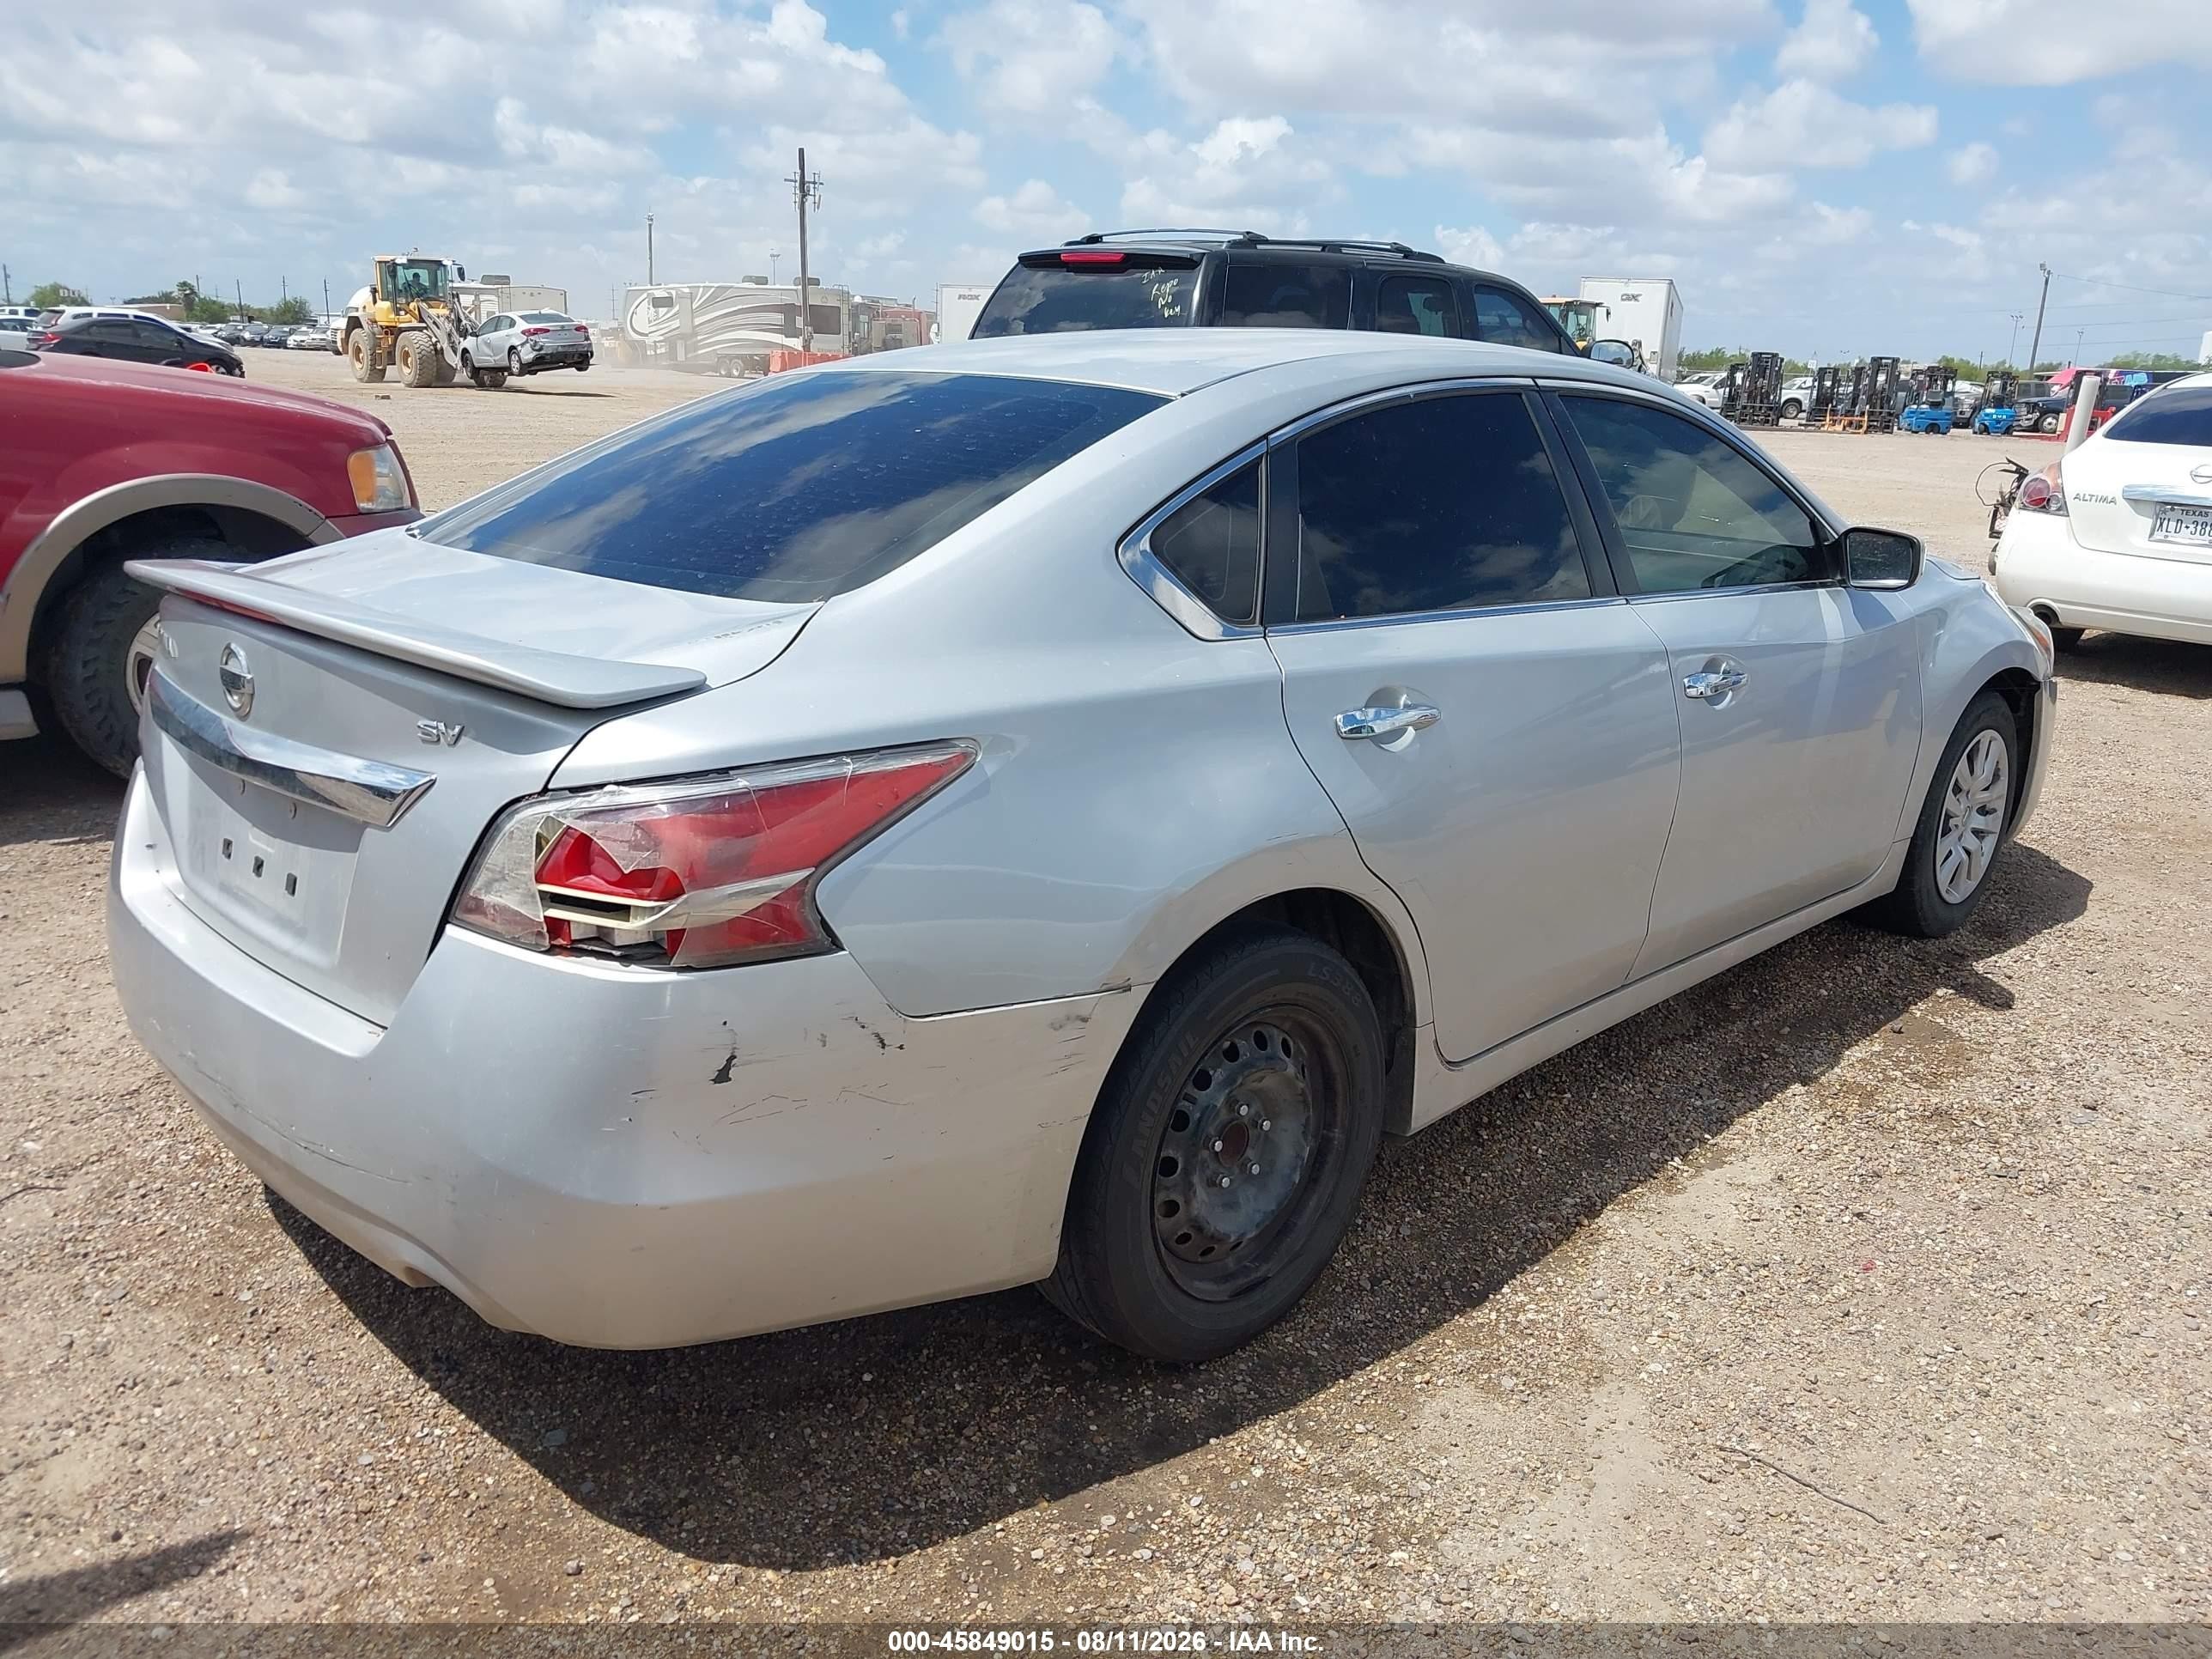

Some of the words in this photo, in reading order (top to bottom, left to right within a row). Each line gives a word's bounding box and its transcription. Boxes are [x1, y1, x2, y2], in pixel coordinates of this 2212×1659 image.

[2073, 492, 2118, 505] ALTIMA
[2180, 508, 2209, 518] TEXAS
[416, 720, 465, 746] SV
